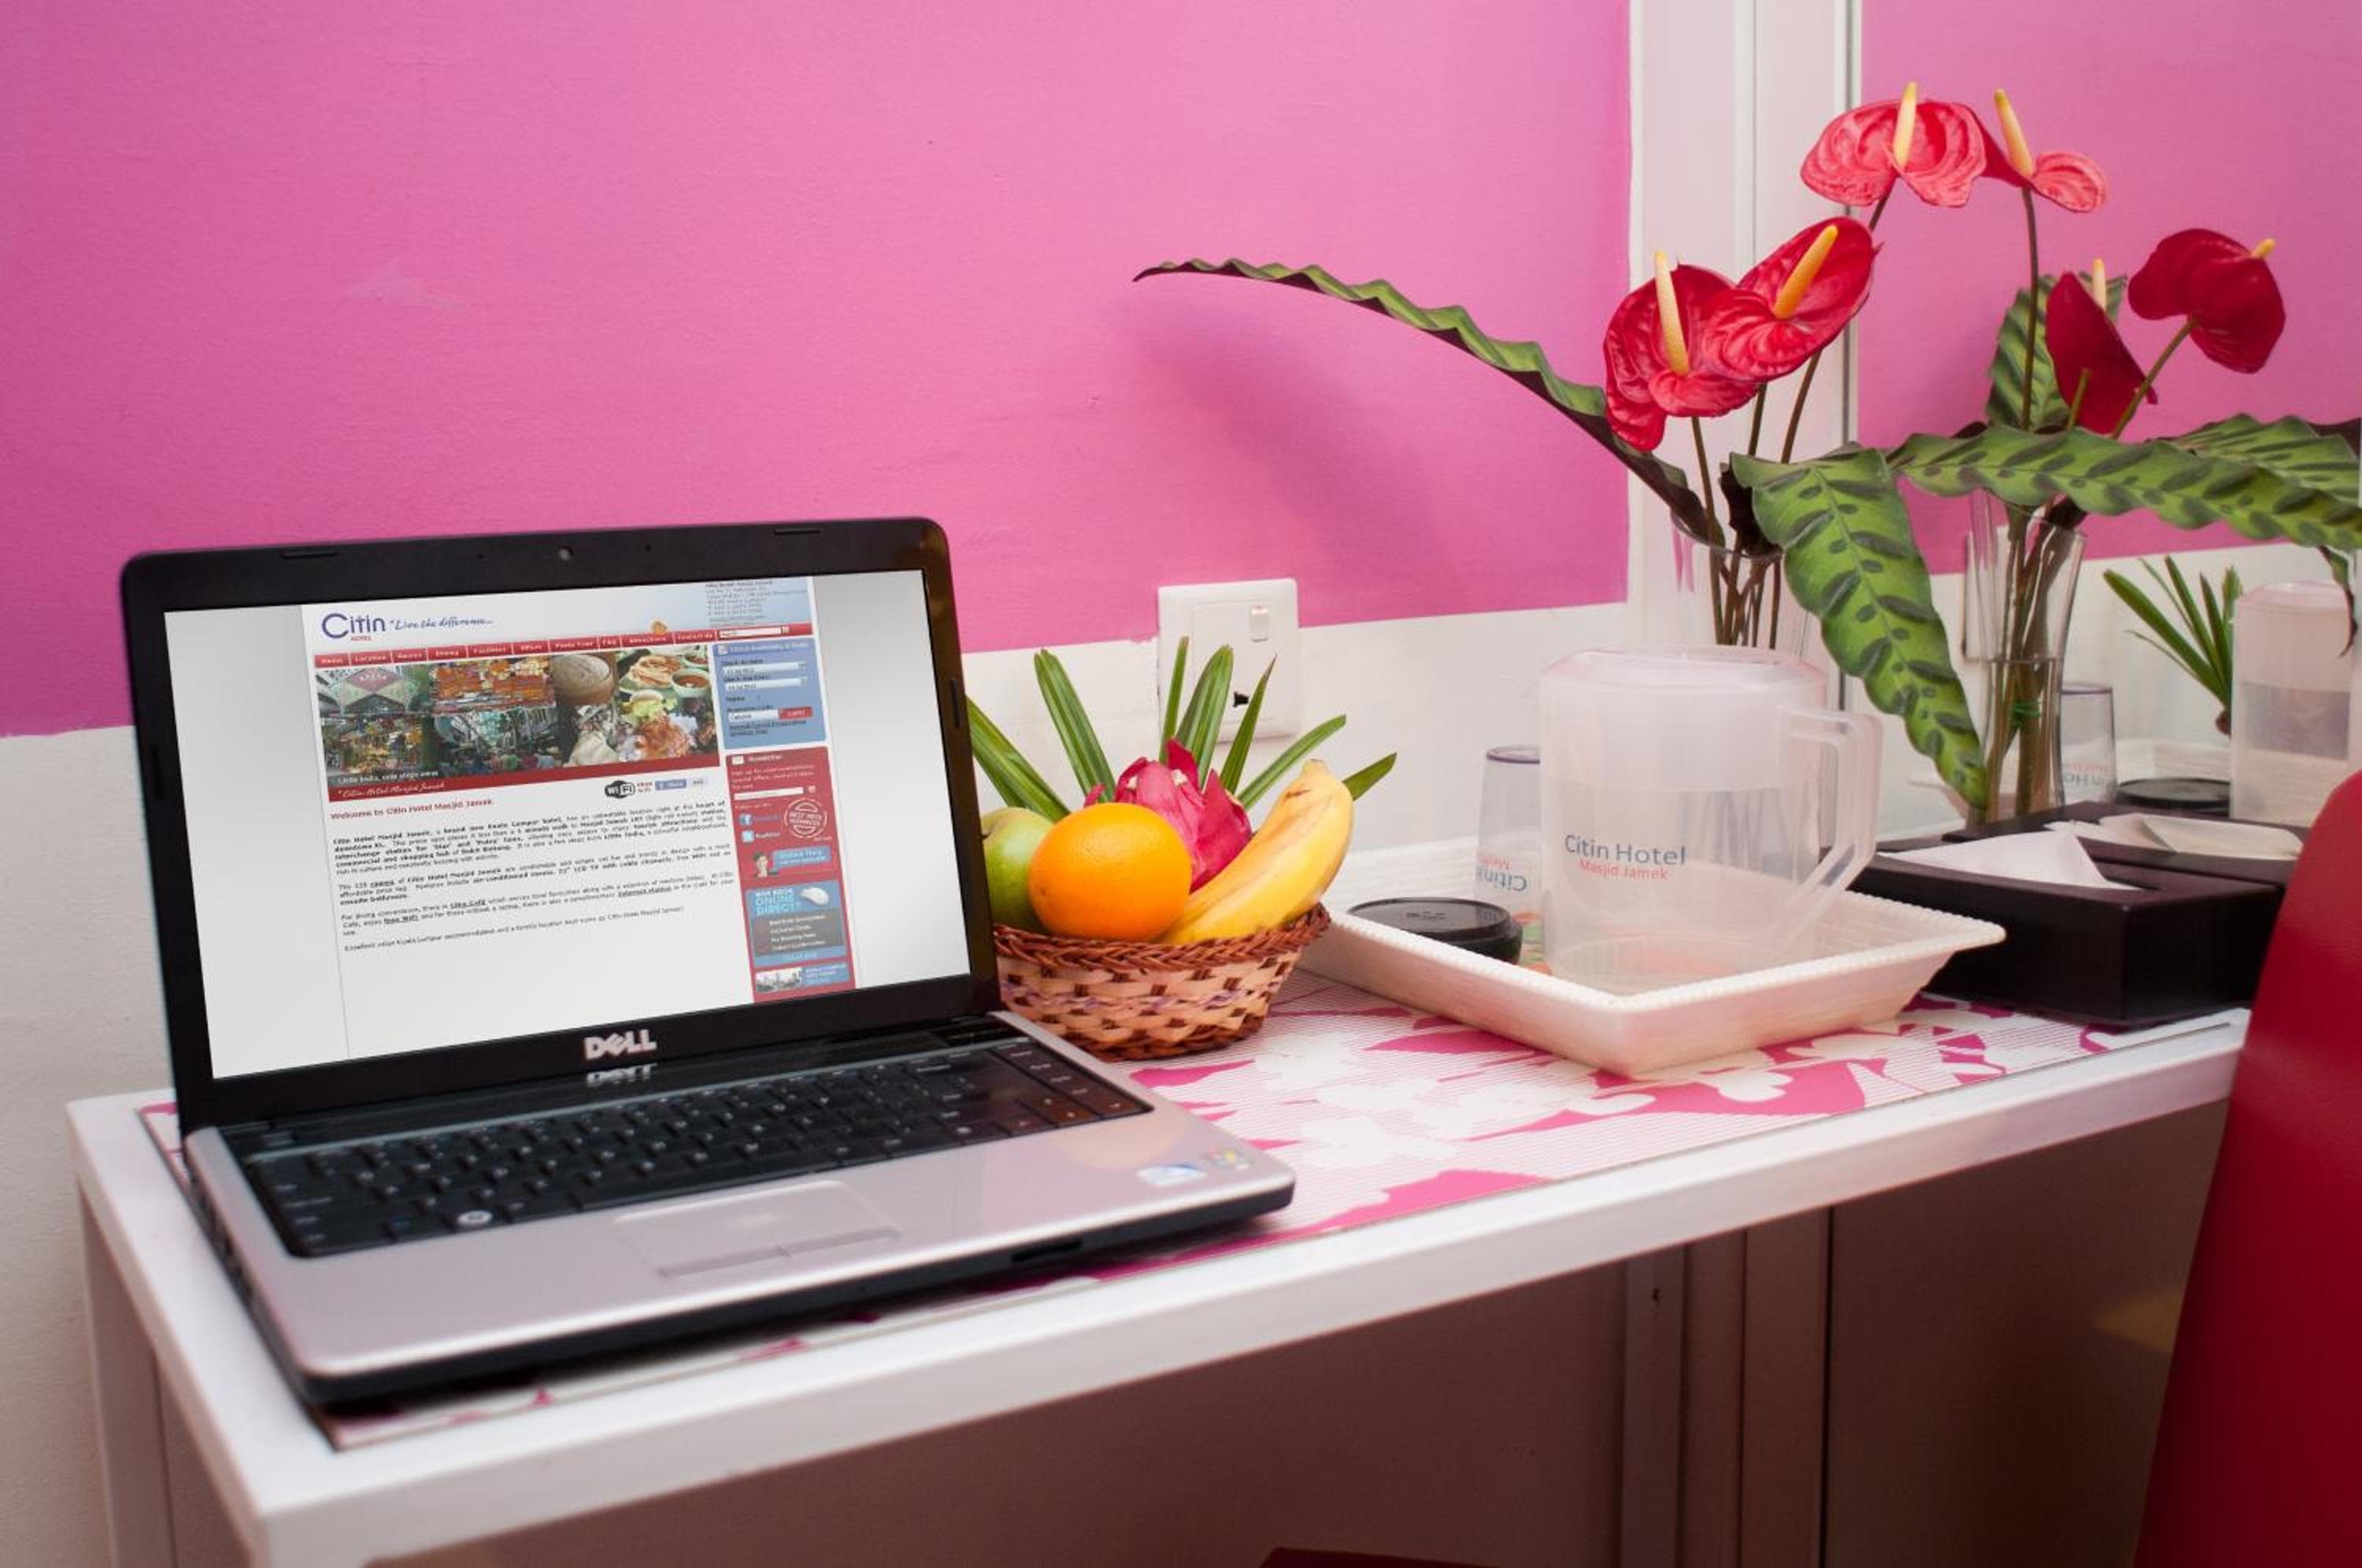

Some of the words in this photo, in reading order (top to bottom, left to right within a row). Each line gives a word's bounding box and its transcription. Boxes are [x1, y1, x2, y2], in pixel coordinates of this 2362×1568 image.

[320, 612, 387, 639] Citin
[330, 809, 372, 820] Welcome
[385, 805, 407, 815] Citin
[408, 804, 432, 812] Hotel
[1564, 834, 1609, 860] Citin
[1616, 843, 1686, 866] Hotel
[1579, 858, 1620, 878] Masjid
[1623, 867, 1668, 881] Jamek
[754, 893, 794, 906] ONLINE
[583, 1029, 657, 1060] DELL
